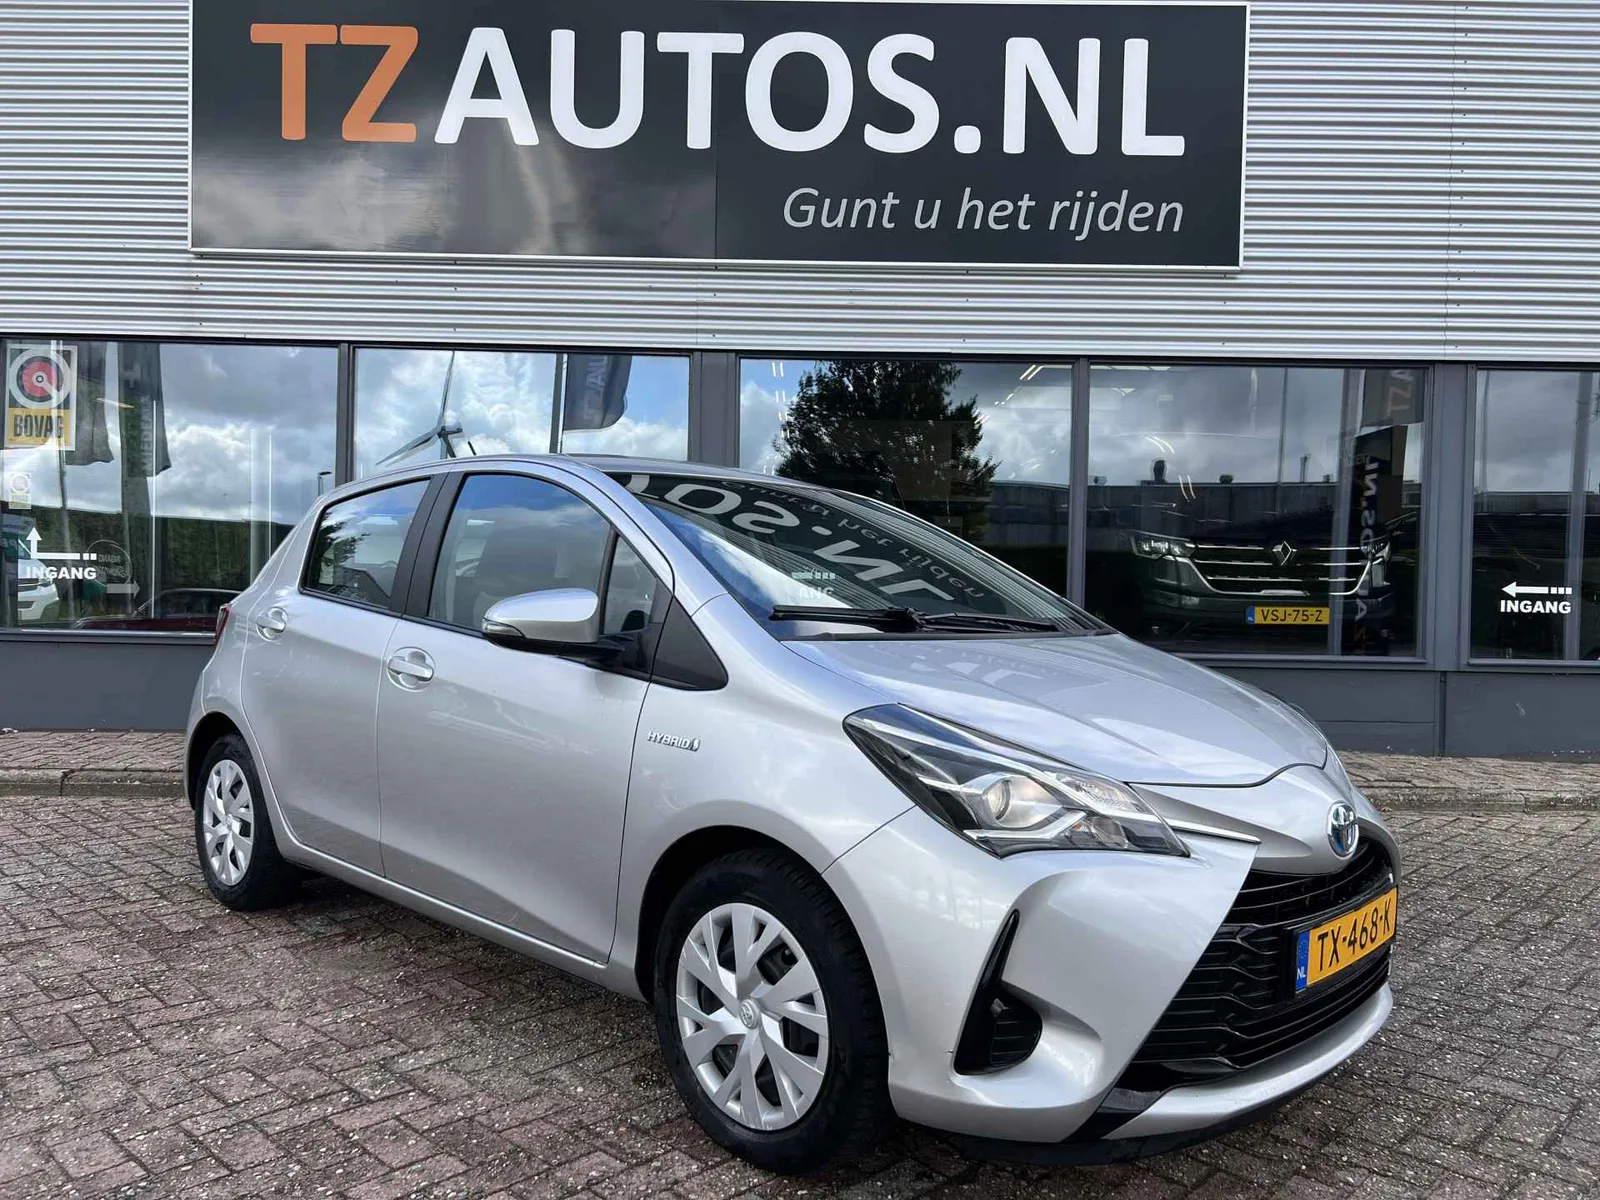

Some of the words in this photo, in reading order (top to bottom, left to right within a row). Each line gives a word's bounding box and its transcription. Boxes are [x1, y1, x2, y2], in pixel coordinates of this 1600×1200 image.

[250, 23, 1185, 157] TZAUTOS.NL
[784, 187, 900, 229] Gunt
[914, 199, 942, 229] u
[957, 187, 1035, 231] het
[1049, 189, 1184, 241] rijden
[13, 414, 64, 439] BOVAG
[25, 566, 97, 580] INGANG
[1260, 609, 1323, 622] VSJ-75-Z
[1500, 599, 1572, 614] INGANG
[647, 731, 692, 750] HYBRID
[1317, 898, 1392, 972] TX-468-K
[1296, 966, 1306, 980] NL
